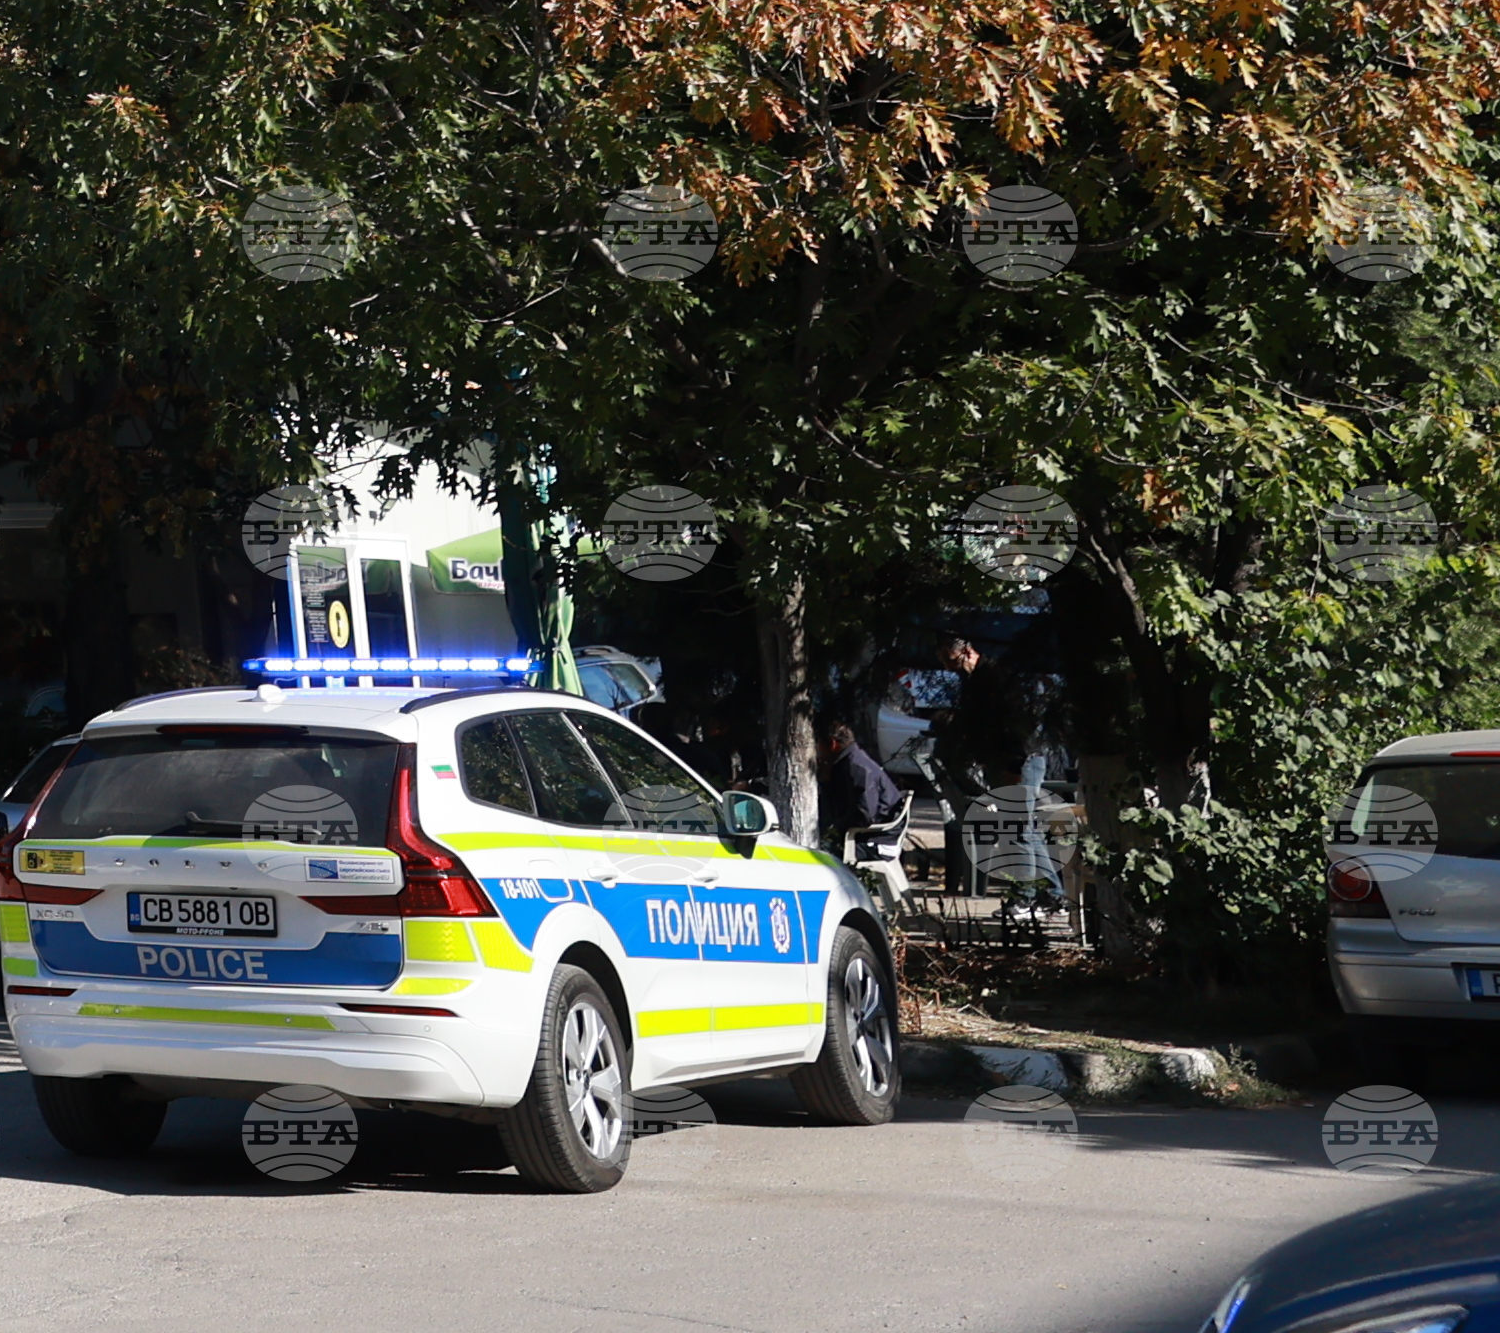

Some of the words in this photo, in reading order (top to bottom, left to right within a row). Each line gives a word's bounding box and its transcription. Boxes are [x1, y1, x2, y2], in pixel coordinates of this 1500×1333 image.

[143, 898, 173, 922] CB
[178, 899, 232, 925] 5881
[239, 901, 270, 926] OB
[646, 899, 760, 952] ПОЛИЦИЯ
[137, 946, 268, 980] POLICE
